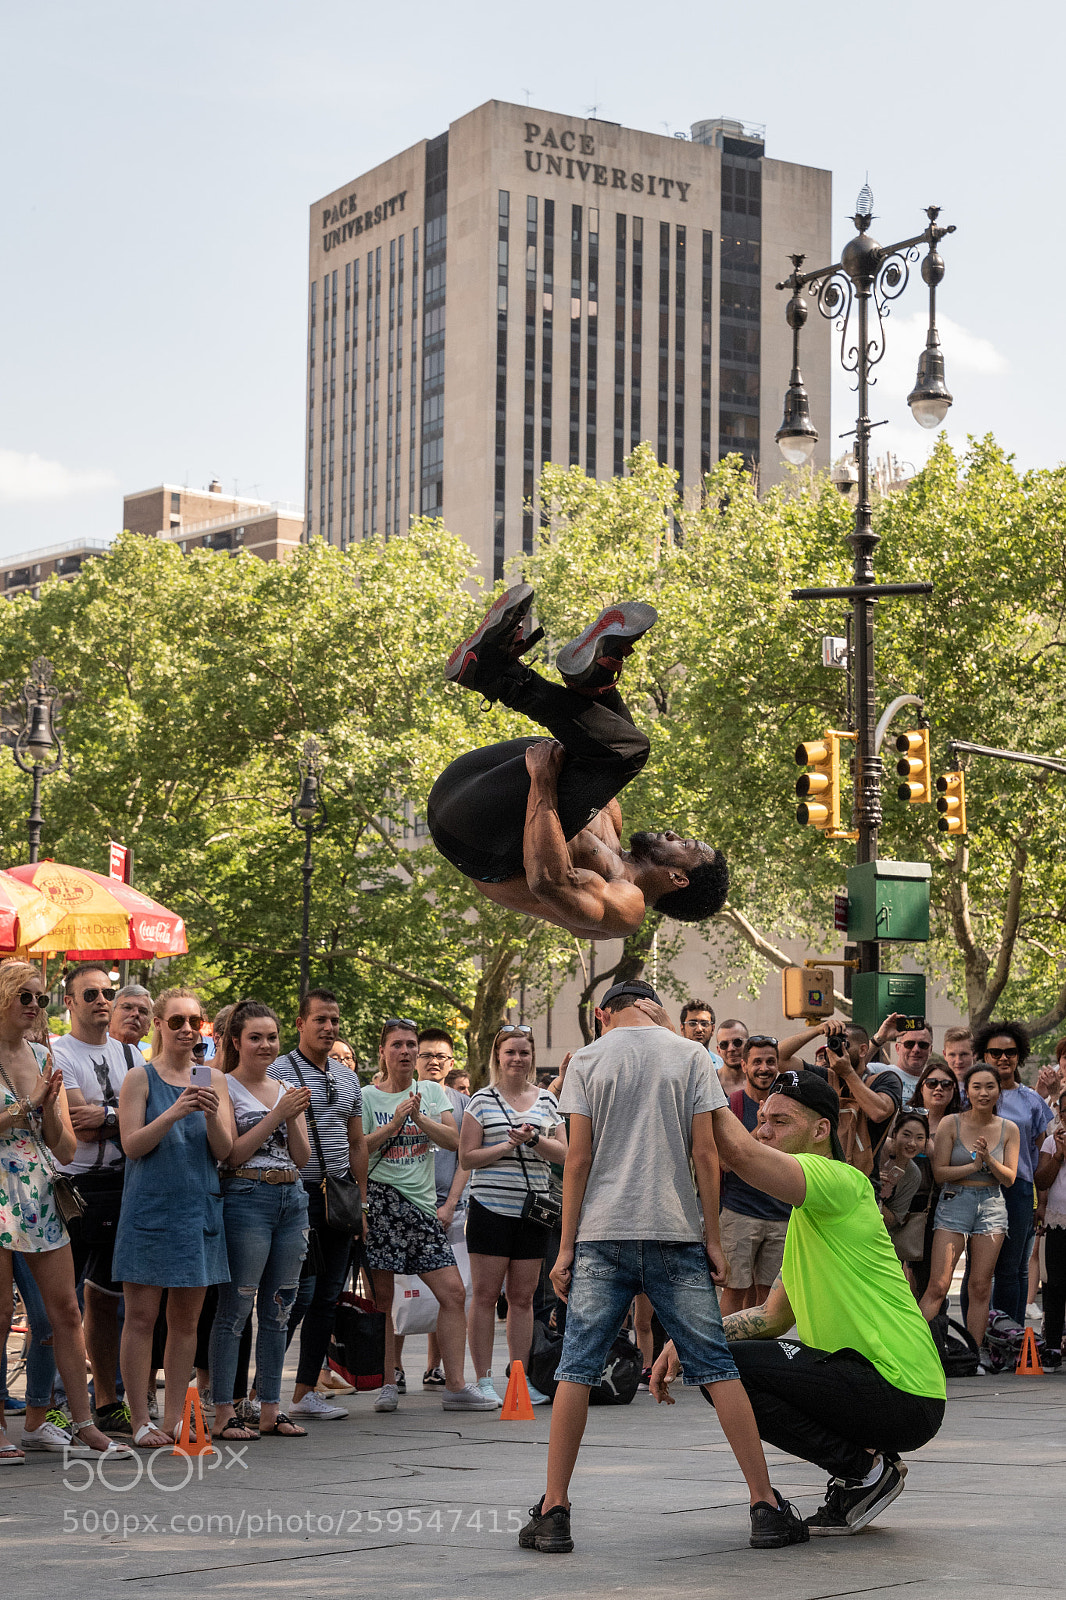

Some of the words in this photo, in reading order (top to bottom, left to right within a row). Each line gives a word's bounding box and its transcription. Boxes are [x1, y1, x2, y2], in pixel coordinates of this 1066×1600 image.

[524, 122, 595, 156] PACE
[524, 149, 692, 202] UNIVERSITY
[322, 192, 358, 229] PACE
[322, 190, 407, 252] UNIVERSITY
[73, 924, 91, 935] Hot
[93, 923, 121, 936] Dogs
[139, 920, 171, 944] Coca-Cola
